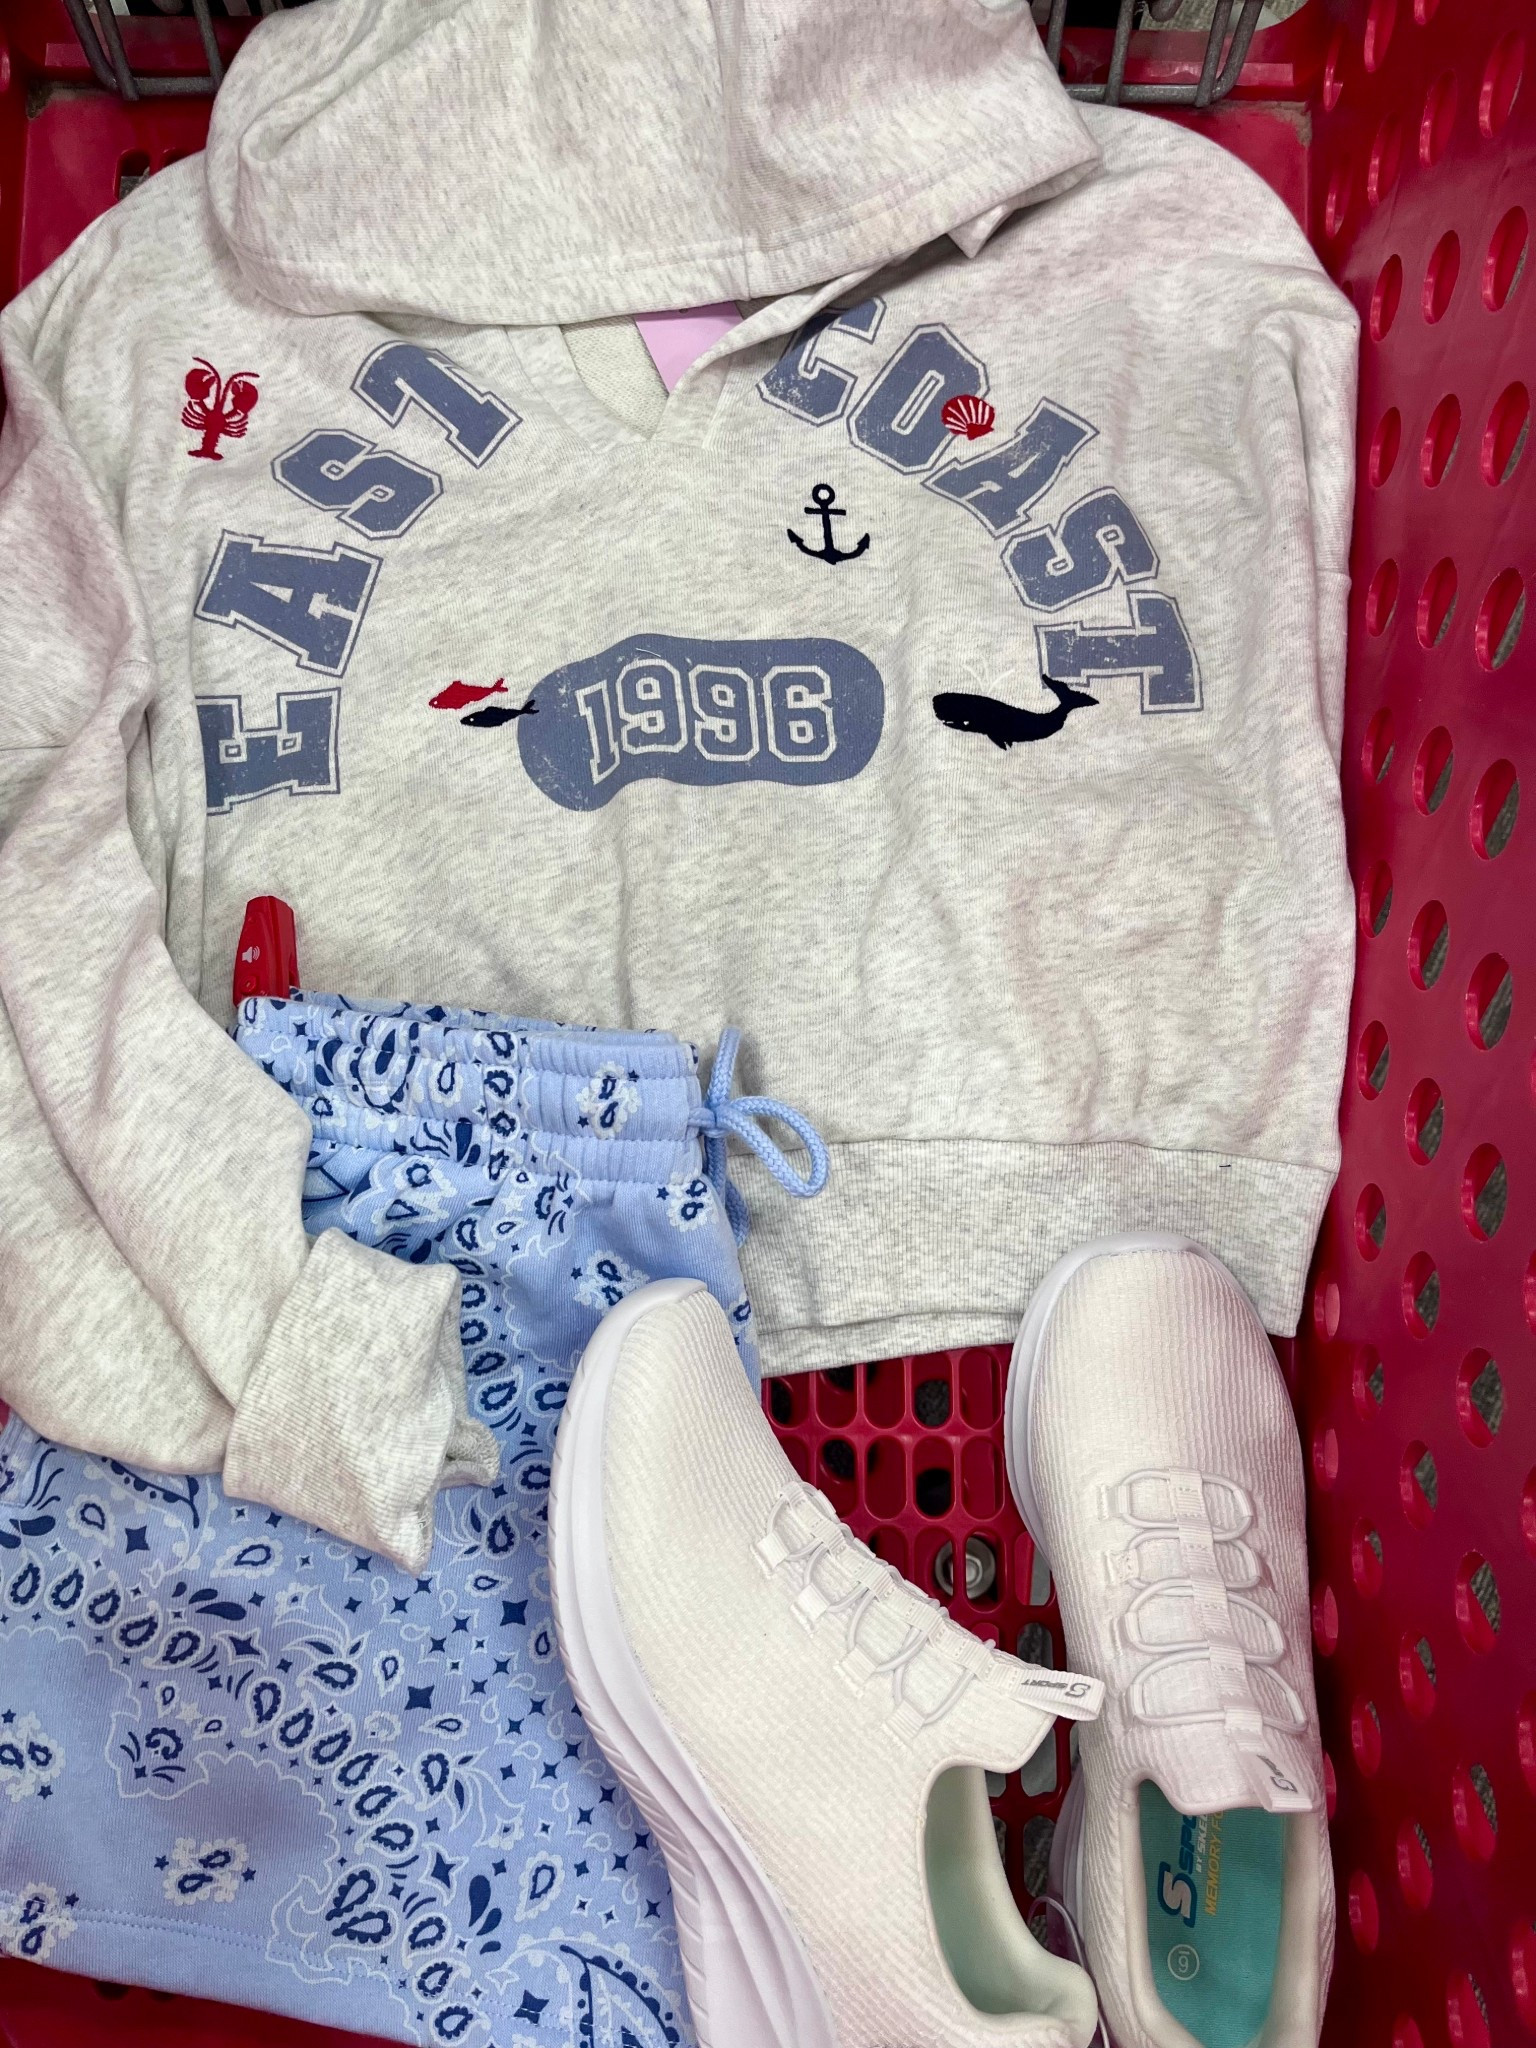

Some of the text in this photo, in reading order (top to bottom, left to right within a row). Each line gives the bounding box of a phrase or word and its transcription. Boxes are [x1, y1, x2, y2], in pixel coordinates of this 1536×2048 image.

[194, 296, 1204, 816] EAST COAST
[575, 658, 838, 786] 1996
[1021, 1678, 1069, 1689] SPORT
[1195, 1857, 1204, 1873] BY
[1204, 1834, 1223, 1917] MEMORY
